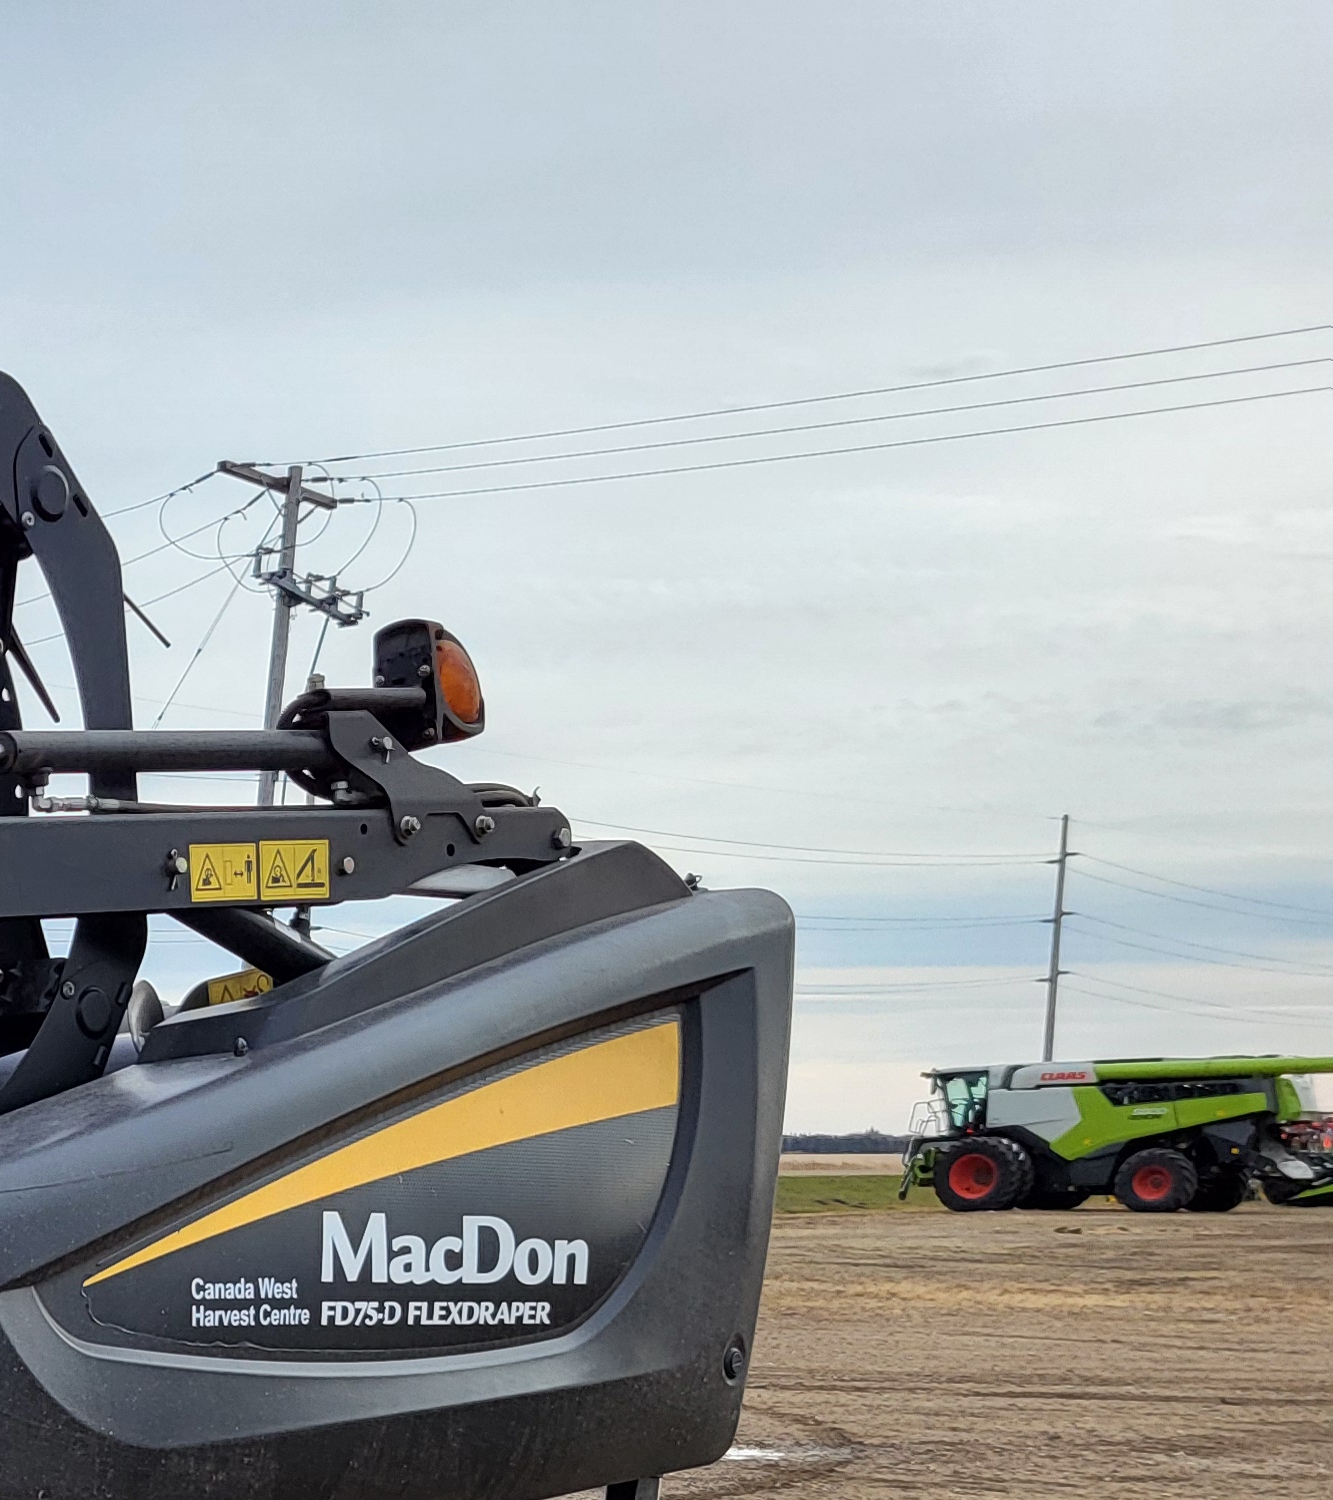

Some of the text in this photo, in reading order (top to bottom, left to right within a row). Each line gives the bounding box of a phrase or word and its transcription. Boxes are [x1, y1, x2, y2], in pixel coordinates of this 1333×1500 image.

[320, 1210, 590, 1285] MacDon
[191, 1277, 298, 1300] Canada West
[191, 1303, 310, 1327] Harvest Centre
[320, 1301, 551, 1326] FD75-D FLEXDRAPER
